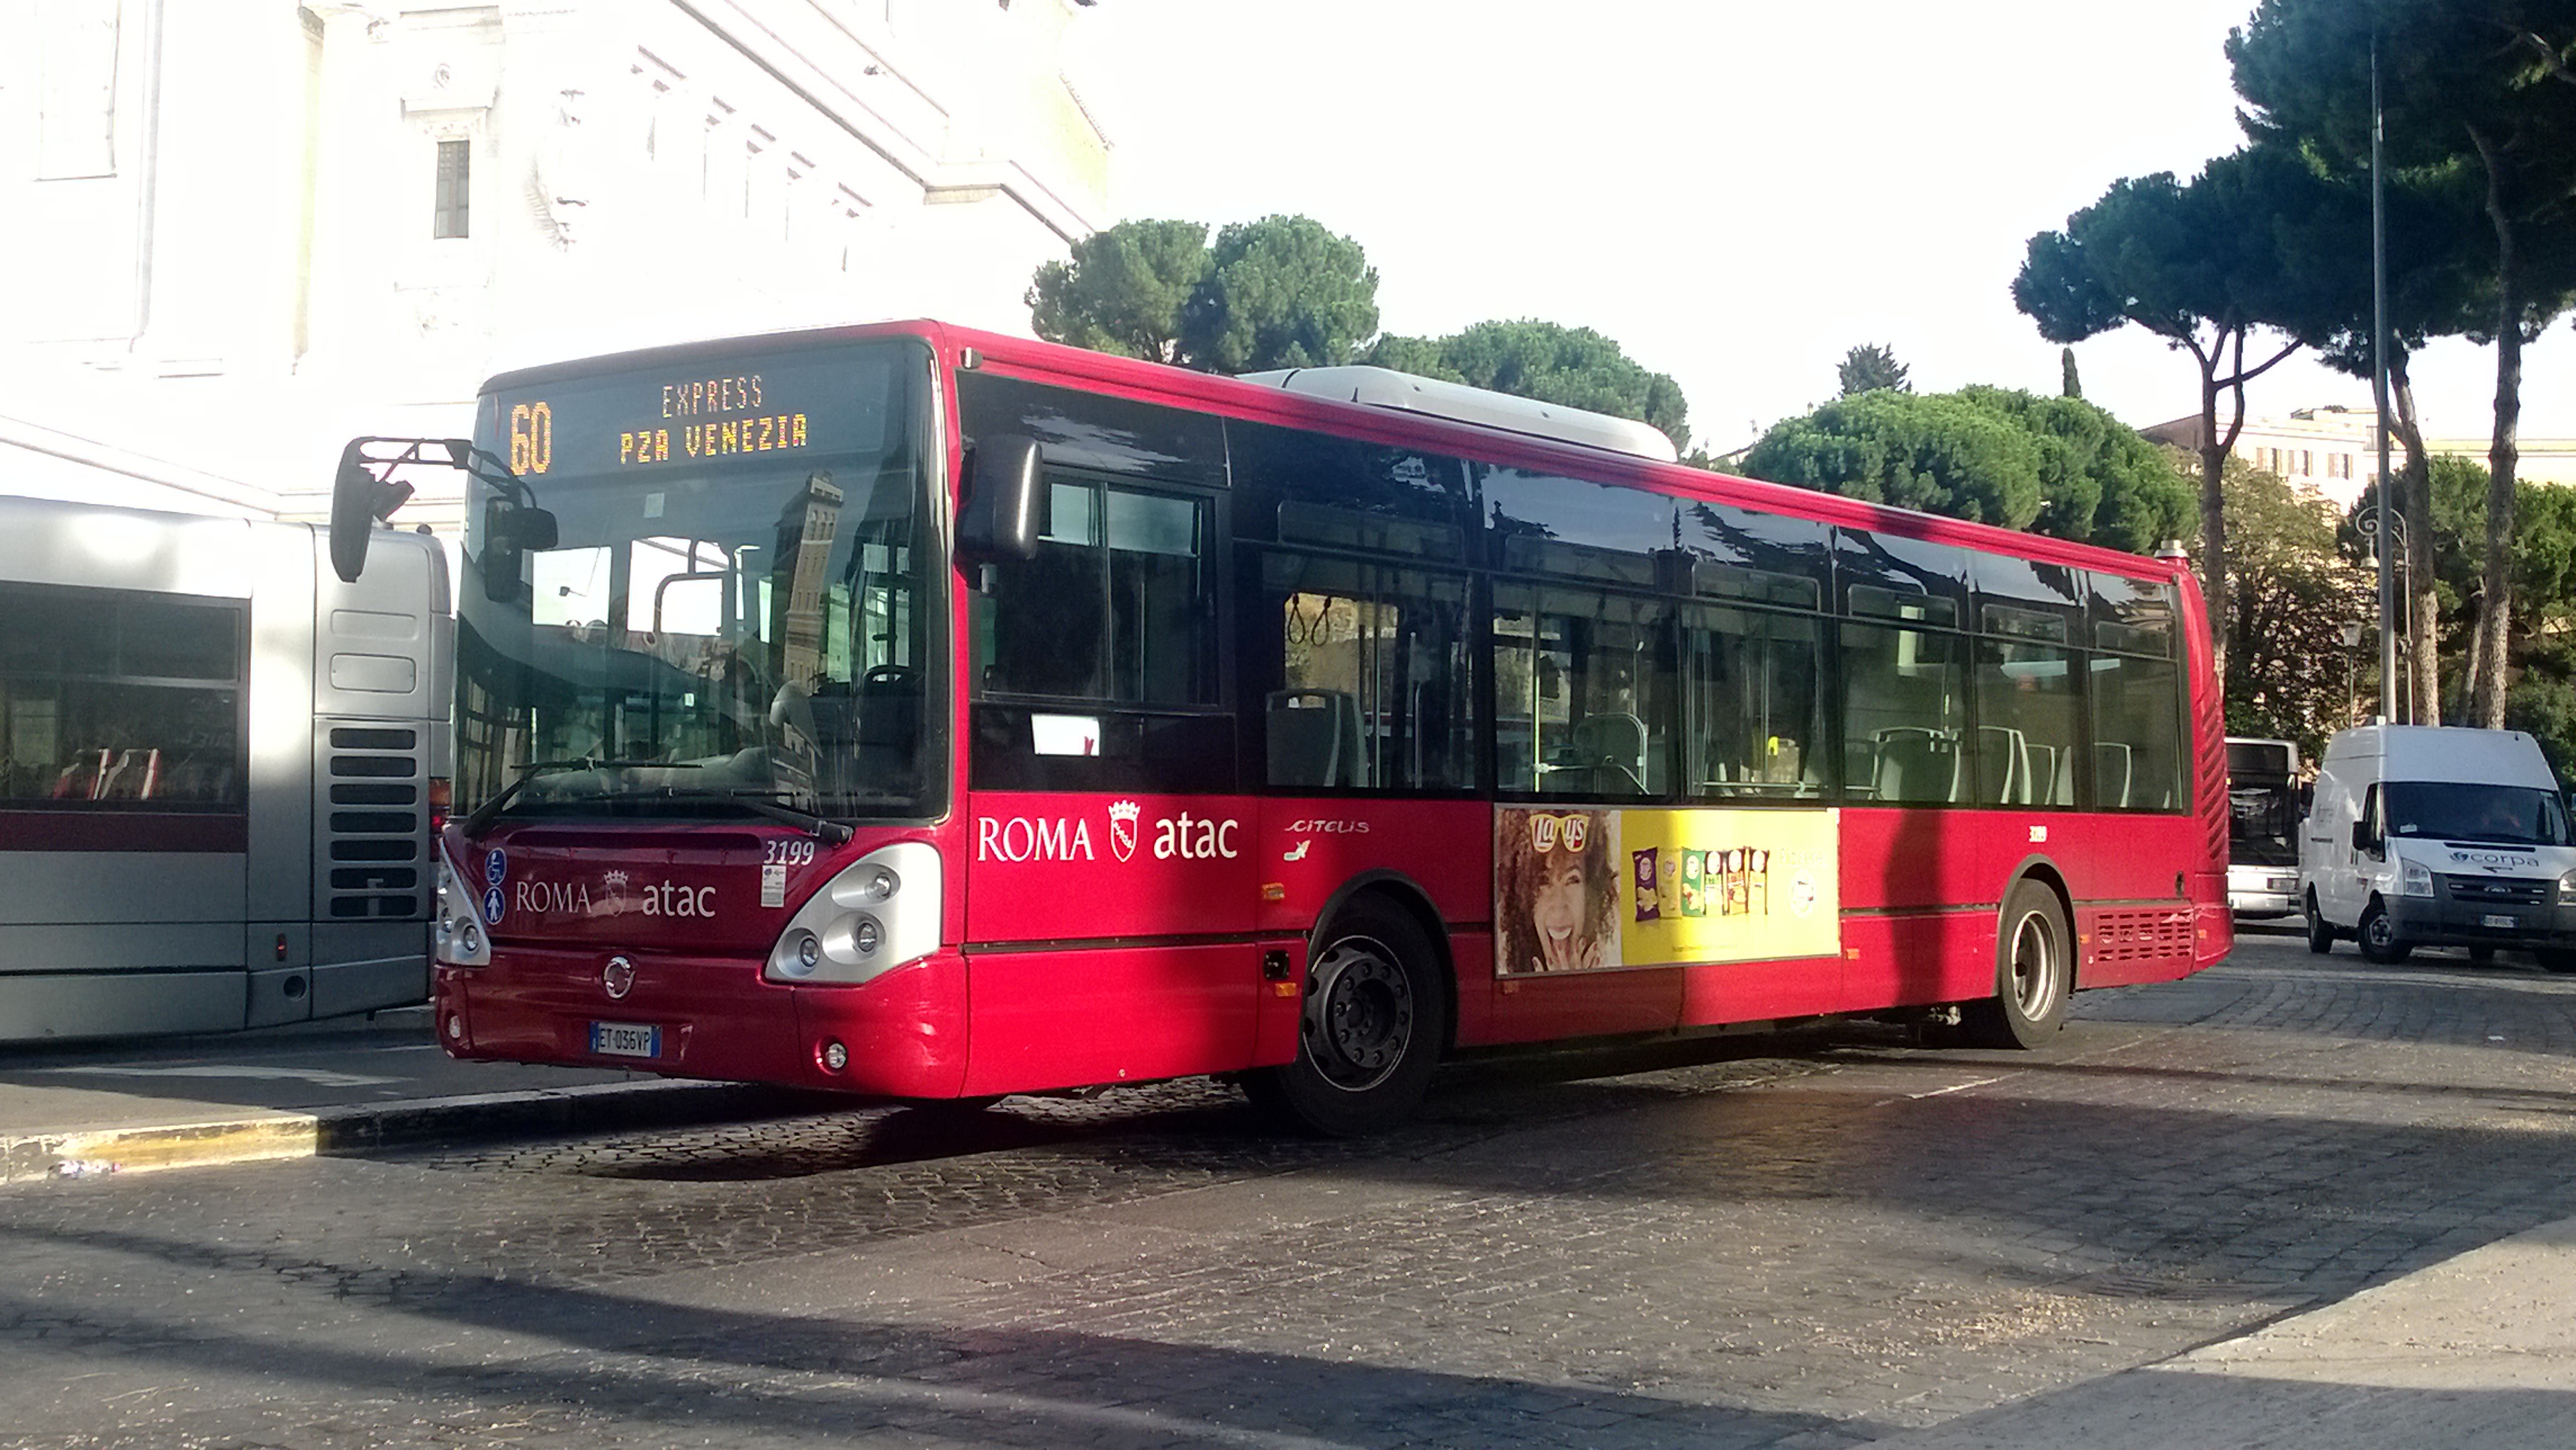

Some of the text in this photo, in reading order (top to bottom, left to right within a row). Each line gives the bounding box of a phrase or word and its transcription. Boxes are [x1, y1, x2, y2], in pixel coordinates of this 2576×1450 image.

[663, 375, 763, 418] EXPRESS
[511, 402, 551, 475] 60
[620, 414, 807, 464] PZA VENEZIA
[763, 840, 814, 866] 3199
[978, 818, 1094, 861] ROMA
[1154, 811, 1238, 858] atac
[516, 882, 592, 914] ROMA
[643, 879, 716, 916] atac
